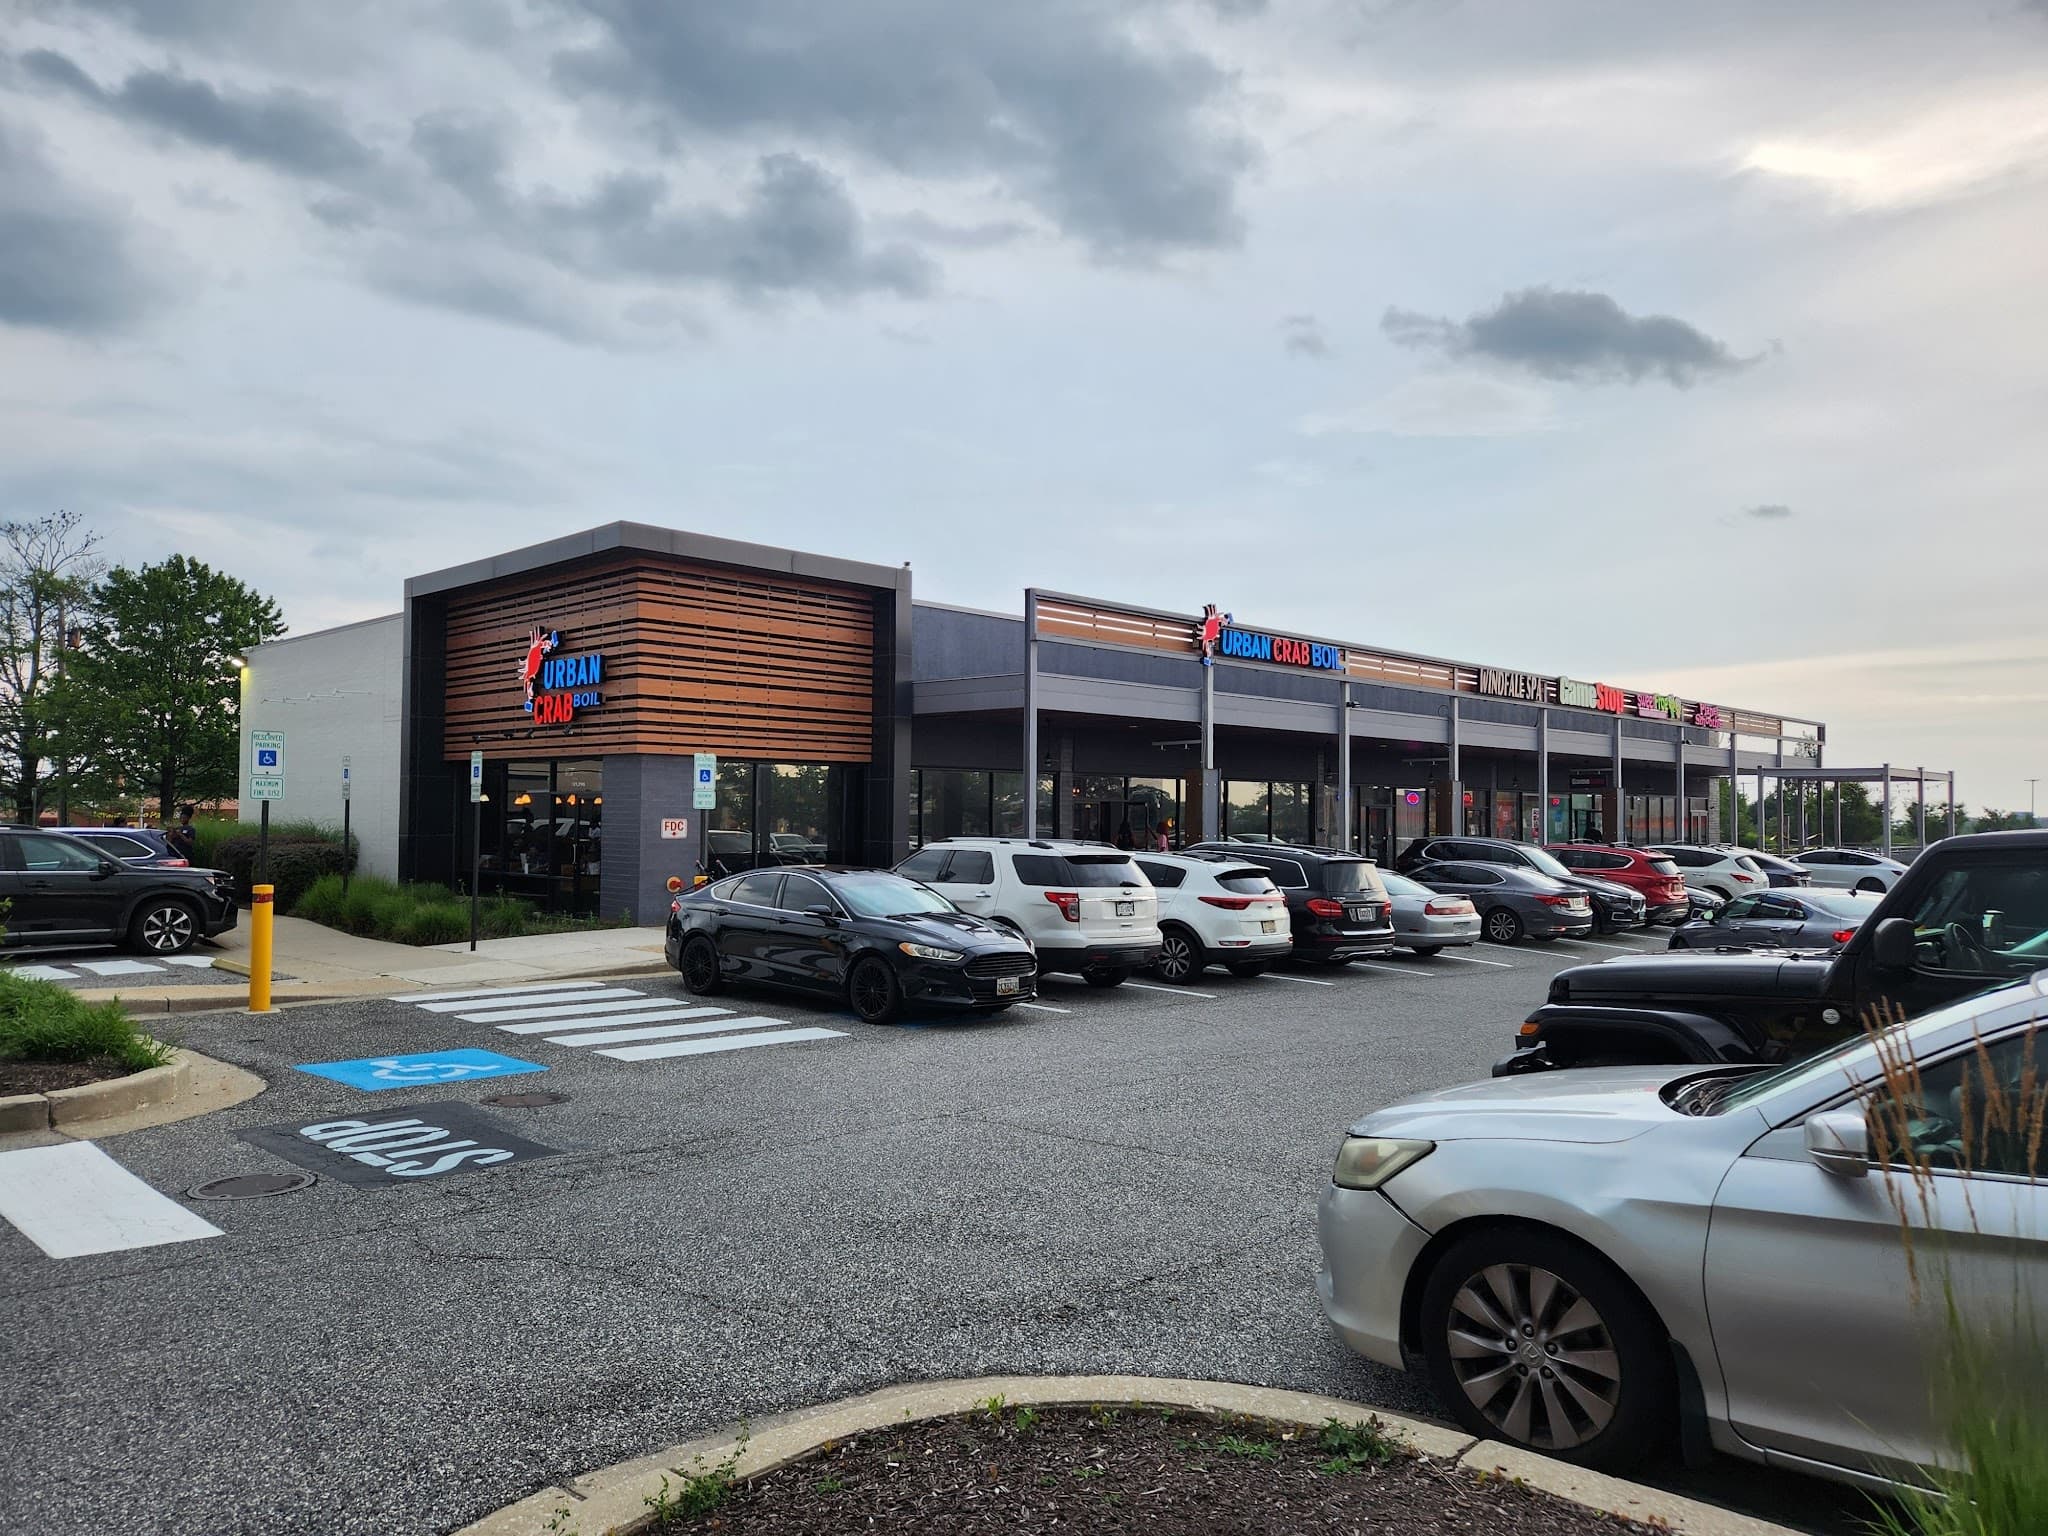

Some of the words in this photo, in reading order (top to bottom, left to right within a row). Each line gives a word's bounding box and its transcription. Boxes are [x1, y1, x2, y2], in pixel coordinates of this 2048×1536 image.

[1222, 630, 1271, 660] URBAN
[1273, 637, 1310, 665] CRAB
[1312, 643, 1344, 671] BOIL
[543, 654, 600, 690] URBAN
[1526, 675, 1542, 702] SPA
[533, 692, 573, 725] CRAB
[573, 692, 600, 708] BOIL
[253, 733, 283, 742] RESERVED
[255, 741, 281, 749] PARKING
[253, 789, 265, 797] FINE
[255, 780, 279, 788] MAXIMUM
[664, 821, 684, 832] FDC
[300, 1118, 514, 1177] STOP
